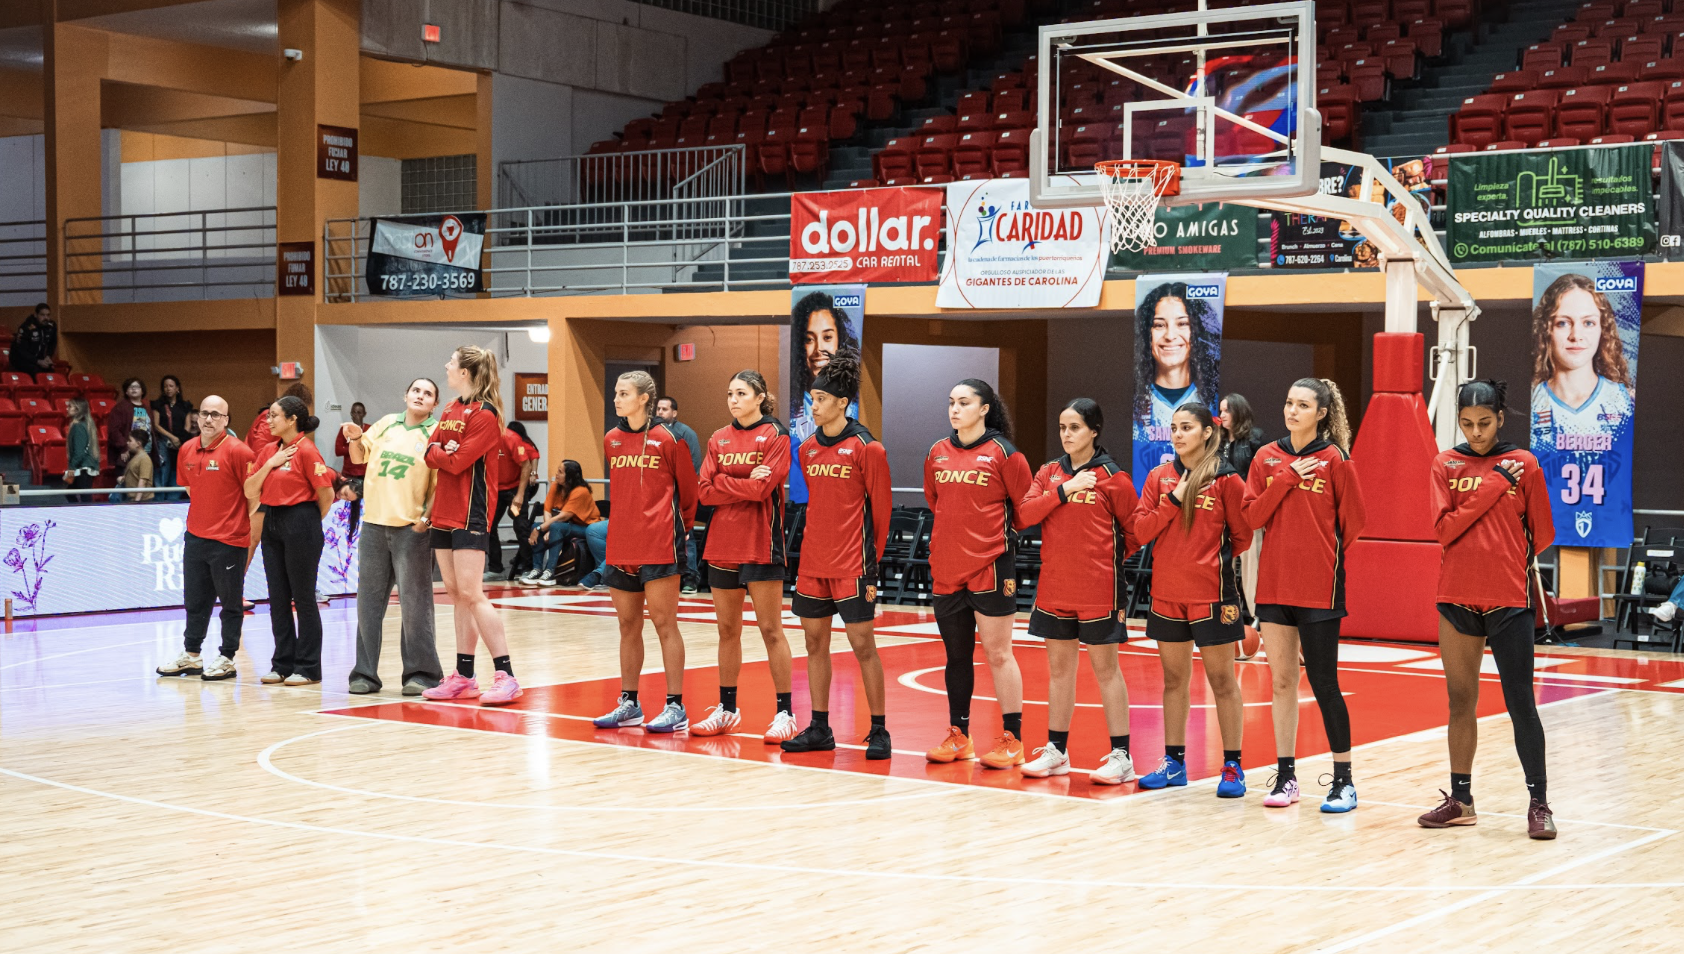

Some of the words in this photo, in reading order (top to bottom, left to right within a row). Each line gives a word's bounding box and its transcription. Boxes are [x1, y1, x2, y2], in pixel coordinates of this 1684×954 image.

[326, 158, 339, 172] LEY
[340, 161, 350, 173] 40
[1474, 182, 1509, 192] Limpieza
[1591, 175, 1632, 184] resultados
[1477, 193, 1508, 202] experta.
[1011, 200, 1034, 211] FAR
[1454, 209, 1520, 223] SPECIALTY
[1523, 206, 1576, 220] QUALITY
[1579, 202, 1646, 217] CLEANERS
[801, 207, 934, 255] dollar.
[996, 211, 1083, 250] CARIDAD
[1176, 219, 1239, 238] AMIGAS
[1479, 229, 1515, 239] ALFOMBRAS
[1519, 227, 1547, 237] MUEBLES
[1552, 225, 1584, 236] MATTRESS
[1588, 224, 1619, 234] CORTINAS
[1143, 246, 1176, 255] PREMIUM
[1178, 245, 1222, 254] SMOKEWARE
[1557, 238, 1587, 252] (787)
[1588, 236, 1645, 250] 510-6389
[856, 256, 878, 268] CAR
[881, 255, 921, 267] RENTAL
[286, 275, 298, 287] LEY
[380, 272, 476, 291] 787-230-3569
[966, 278, 1012, 287] GIGANTES
[1014, 277, 1026, 286] DE
[1028, 276, 1078, 286] CAROLINA
[1597, 278, 1634, 291] GOYA
[1188, 286, 1218, 298] GOYA
[834, 296, 859, 307] GOYA
[522, 396, 548, 411] GENER
[1555, 433, 1612, 451] BERGER
[378, 460, 409, 480] 14
[1561, 463, 1605, 505] 34
